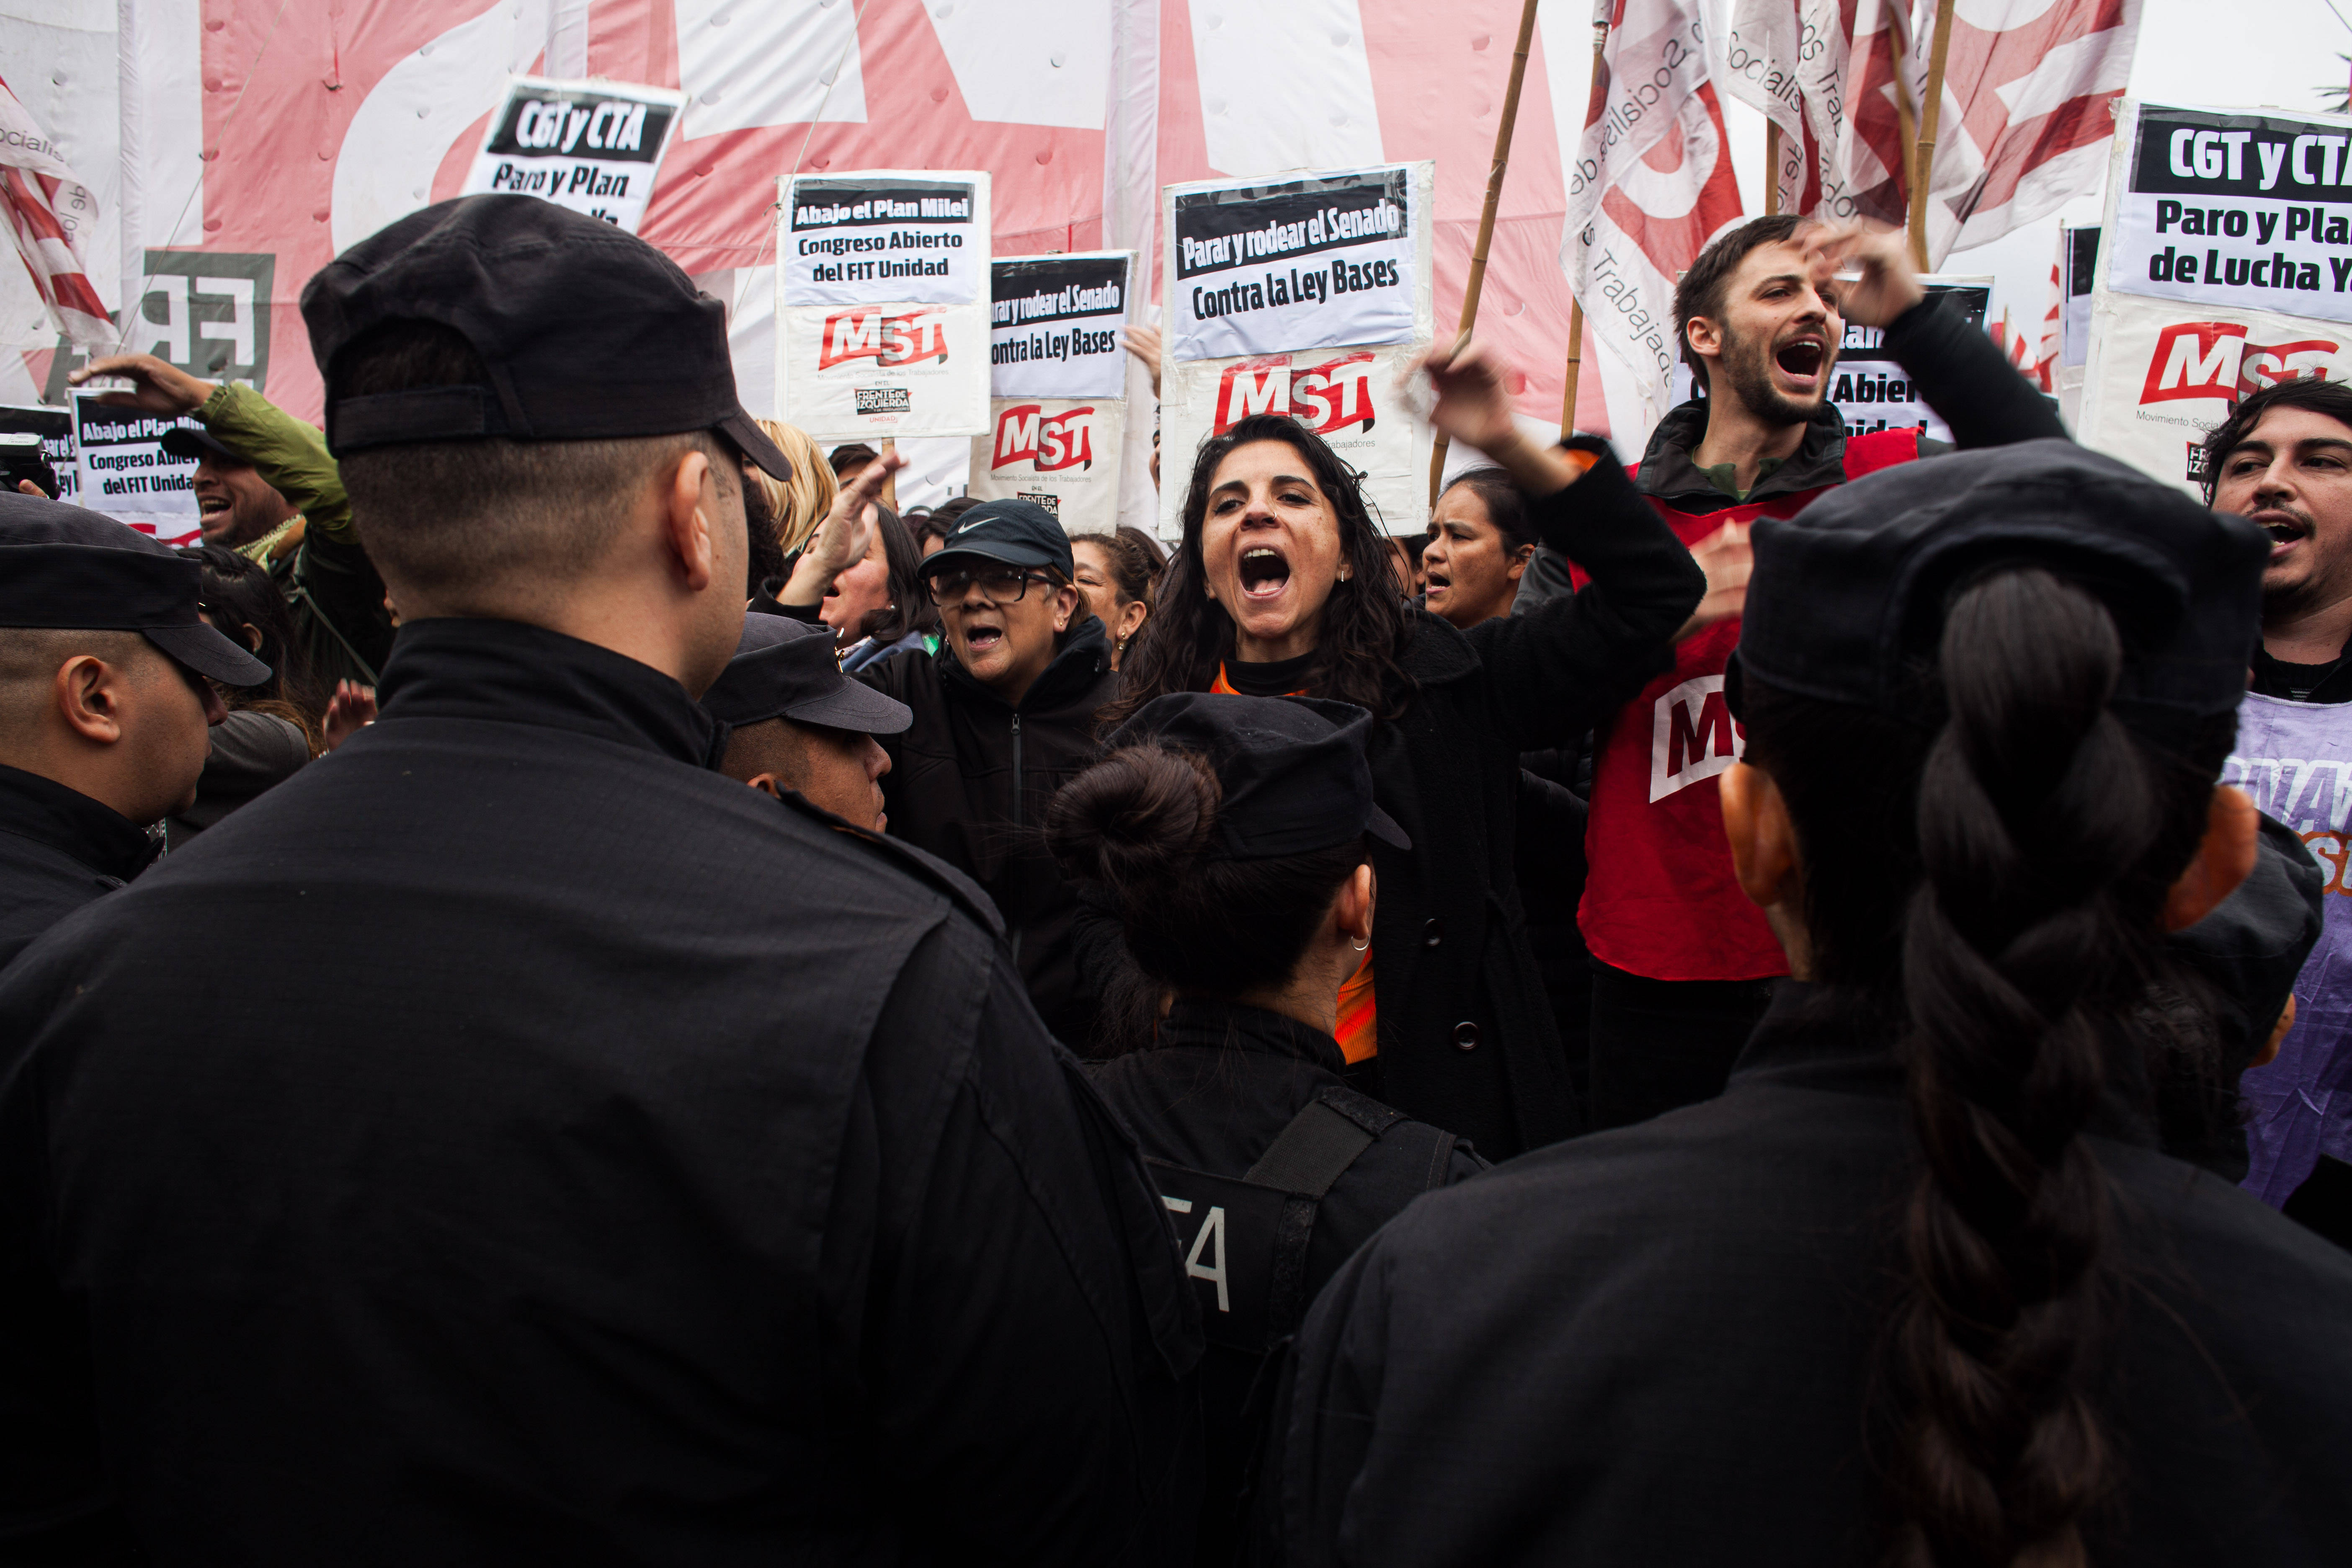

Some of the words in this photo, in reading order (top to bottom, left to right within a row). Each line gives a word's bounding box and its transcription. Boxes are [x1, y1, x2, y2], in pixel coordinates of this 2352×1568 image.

[516, 100, 572, 149] CGT
[561, 108, 590, 153] y
[586, 101, 647, 151] CTA
[2170, 129, 2251, 181] CGT
[2258, 142, 2286, 190] y
[492, 163, 546, 191] Paro
[547, 170, 566, 196] y
[568, 165, 629, 198] Plan
[796, 203, 852, 225] Abajo
[852, 201, 872, 218] el
[874, 200, 918, 218] Plan
[921, 198, 968, 217] Milei
[2156, 200, 2247, 237] Paro
[2256, 212, 2279, 245] y
[2285, 206, 2352, 246] Pla
[799, 236, 885, 255] Congreso
[889, 232, 962, 250] Abierto
[1182, 235, 1231, 271] Parar
[1231, 233, 1244, 266] y
[1246, 221, 1306, 257] rodear
[1308, 210, 1326, 245] el
[1329, 199, 1399, 242] Senado
[813, 263, 843, 281] del
[847, 262, 874, 281] FIT
[879, 258, 948, 278] Unidad
[2148, 246, 2197, 284] de
[2204, 249, 2321, 292] Lucha
[2329, 257, 2352, 292] Y
[1011, 299, 1019, 325] y
[1019, 290, 1059, 320] rodear
[1058, 285, 1071, 313] el
[1072, 281, 1119, 312] Senado
[1193, 281, 1264, 320] Contra
[1266, 272, 1290, 308] la
[1292, 268, 1328, 304] Ley
[1333, 258, 1398, 294] Bases
[830, 313, 943, 361] MST
[991, 338, 1027, 365] ontra
[1030, 333, 1043, 360] la
[1045, 331, 1069, 361] Ley
[1073, 328, 1114, 355] Bases
[1839, 319, 1885, 349] lan
[857, 389, 895, 400] FRENTE
[1226, 361, 1369, 429] MST
[1833, 374, 1916, 402] Abier
[857, 398, 909, 409] IZQUIERDA
[2136, 410, 2189, 426] Movimiento
[83, 421, 126, 442] Abajo
[127, 419, 141, 438] el
[1000, 412, 1089, 465] MST
[89, 453, 154, 471] Congreso
[59, 475, 72, 496] ey
[103, 477, 127, 495] del
[127, 477, 148, 493] FIT
[150, 474, 193, 492] Unida
[1059, 475, 1091, 484] Trabajadores
